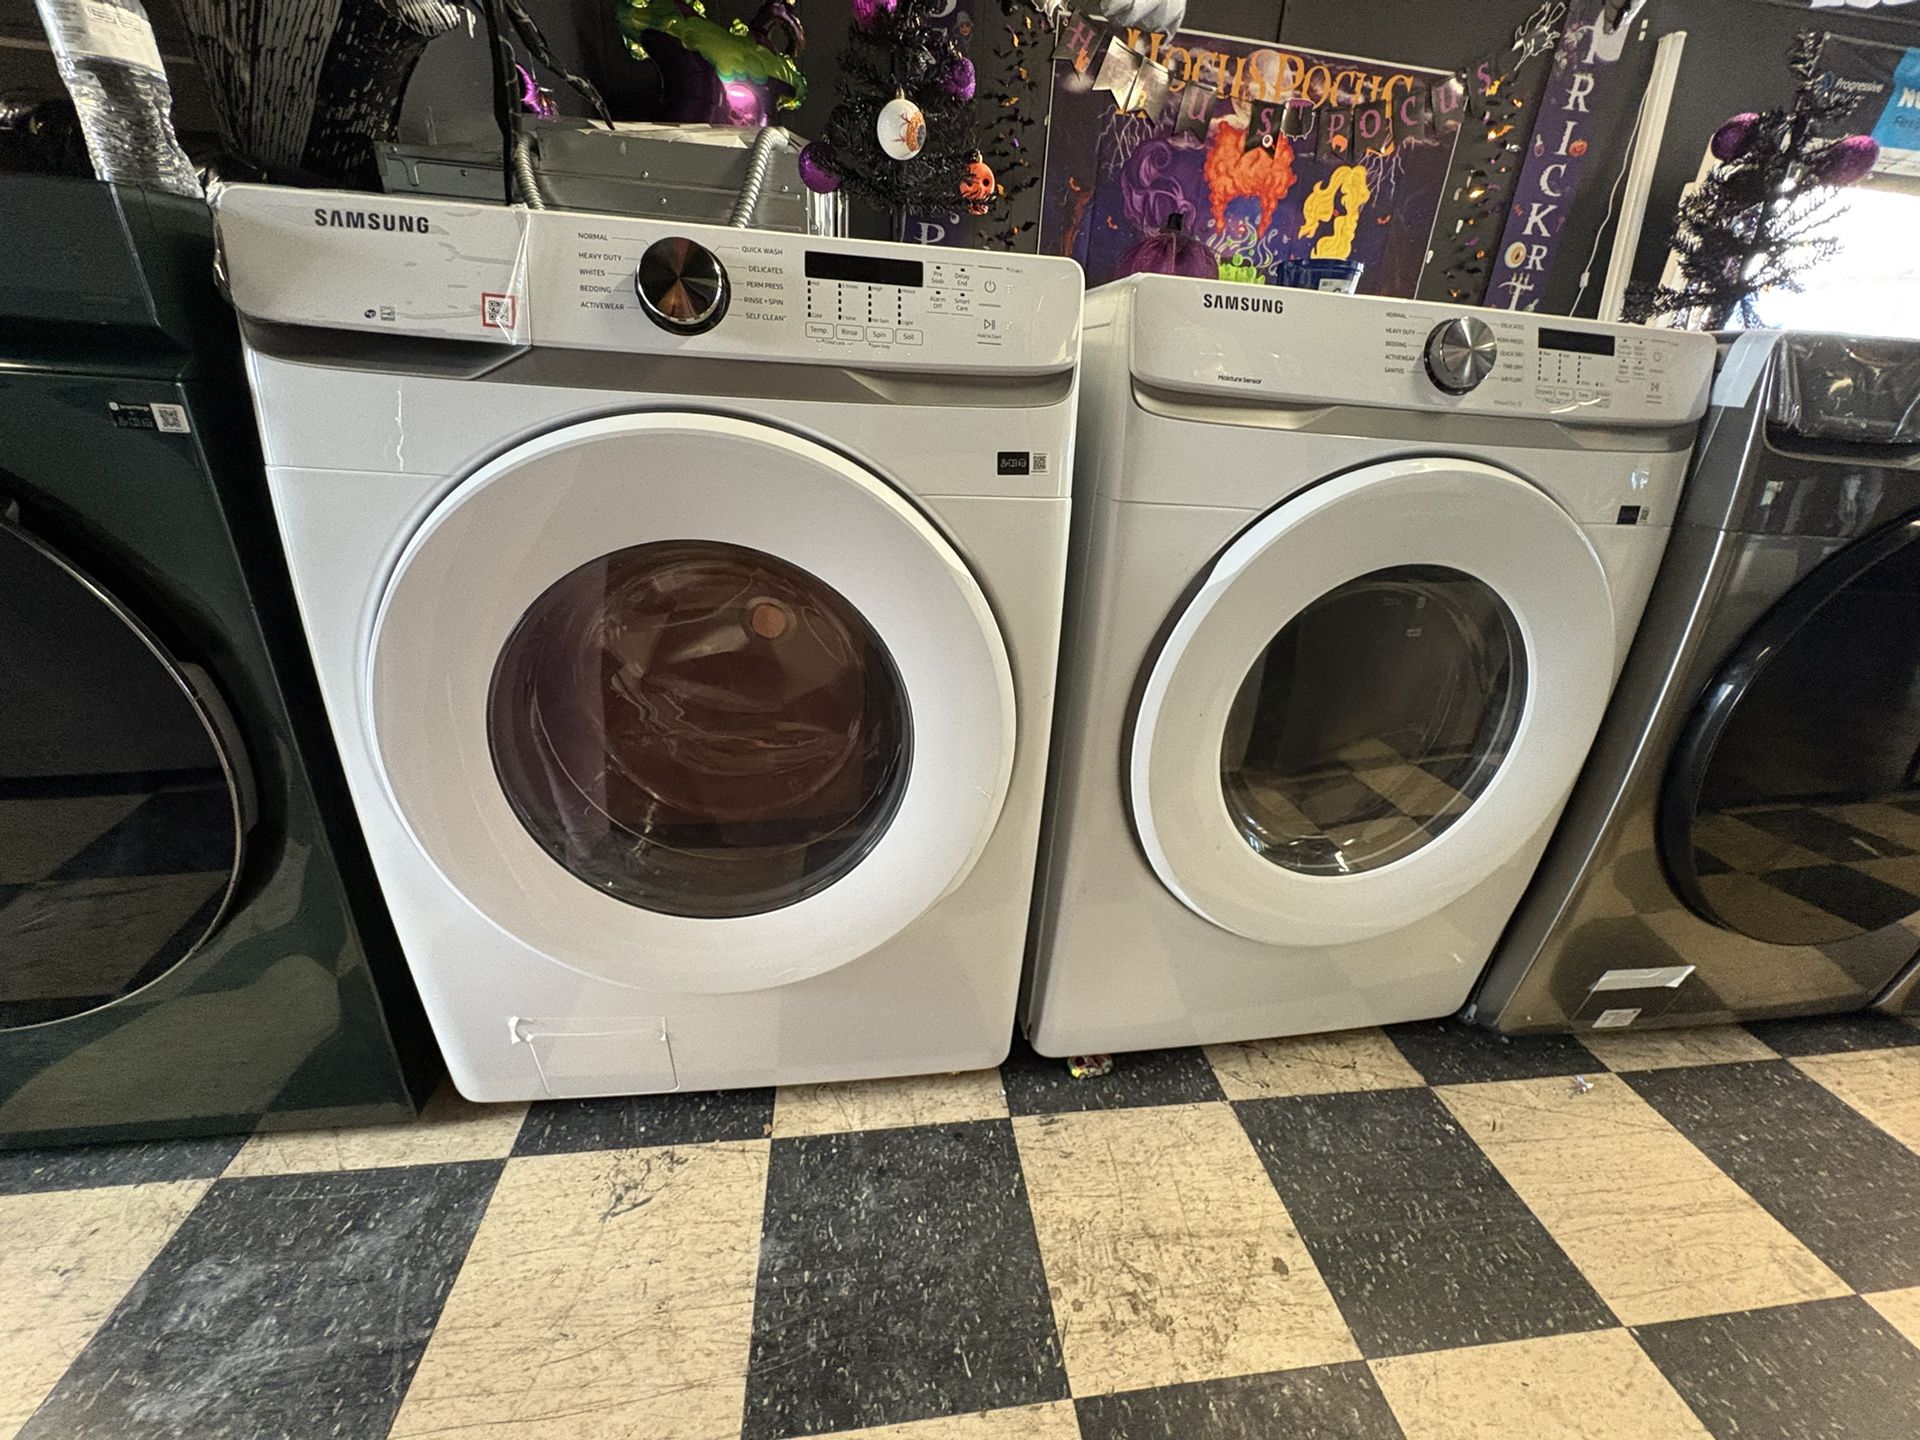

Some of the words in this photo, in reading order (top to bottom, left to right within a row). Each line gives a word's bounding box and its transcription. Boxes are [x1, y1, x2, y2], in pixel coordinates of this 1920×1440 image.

[1835, 78, 1884, 92] Progressive
[314, 208, 430, 234] SAMSUNG
[578, 232, 609, 242] NORMAL
[741, 246, 762, 254] QUICK
[763, 247, 783, 256] WASH
[578, 252, 602, 261] HEAVY
[603, 253, 622, 262] DUTY
[579, 268, 605, 277] WHITES
[748, 265, 783, 275] DELICATES
[580, 284, 611, 294] BEDDING
[746, 281, 763, 289] PERM
[764, 282, 784, 291] PRESS
[581, 301, 624, 311] ACTIVEWEAR
[743, 296, 762, 305] RINSE
[768, 297, 783, 306] SPIN
[1203, 293, 1284, 315] SAMSUNG
[746, 312, 760, 321] SELF
[873, 331, 887, 339] Spin
[1217, 374, 1242, 383] Moisture
